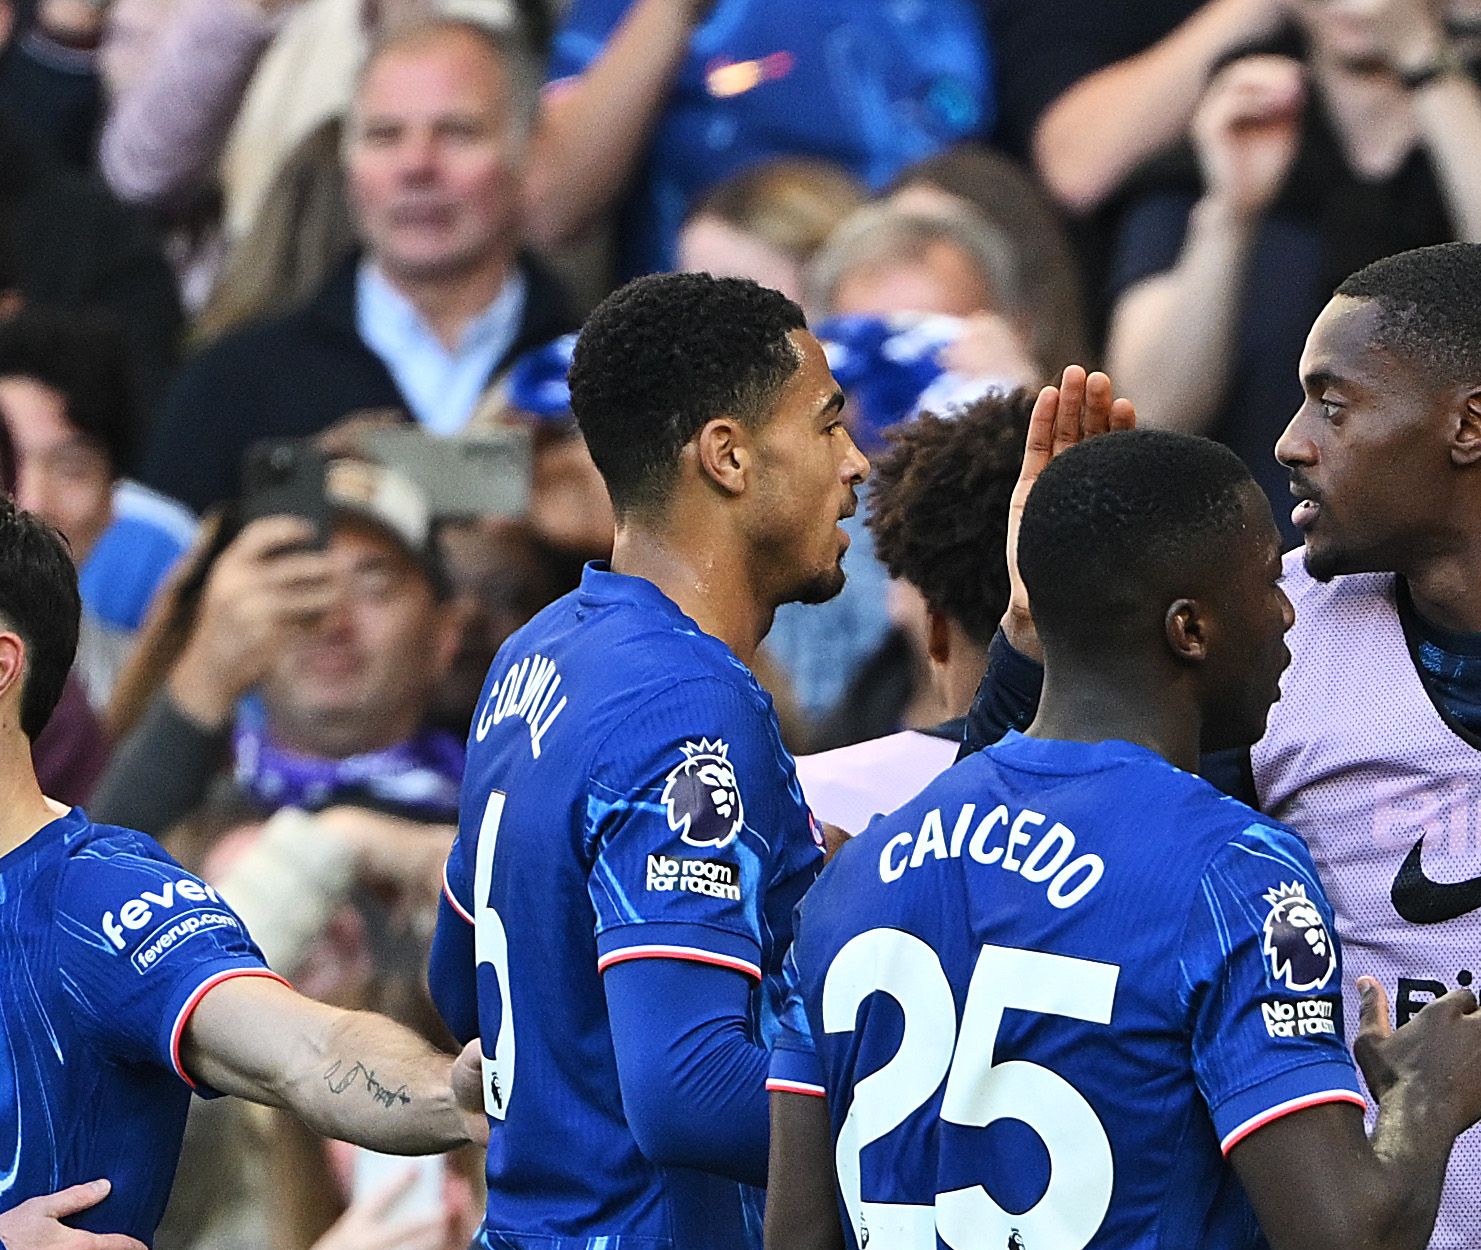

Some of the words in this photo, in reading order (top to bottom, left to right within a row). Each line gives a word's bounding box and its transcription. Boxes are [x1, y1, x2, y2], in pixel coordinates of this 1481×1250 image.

[646, 854, 680, 876] No
[681, 860, 732, 884] room
[879, 803, 1106, 909] CAICEDO
[646, 872, 678, 891] for
[102, 879, 221, 950] fever
[138, 913, 238, 968] feverup.com
[1261, 1001, 1295, 1021] No
[1266, 1019, 1296, 1038] for
